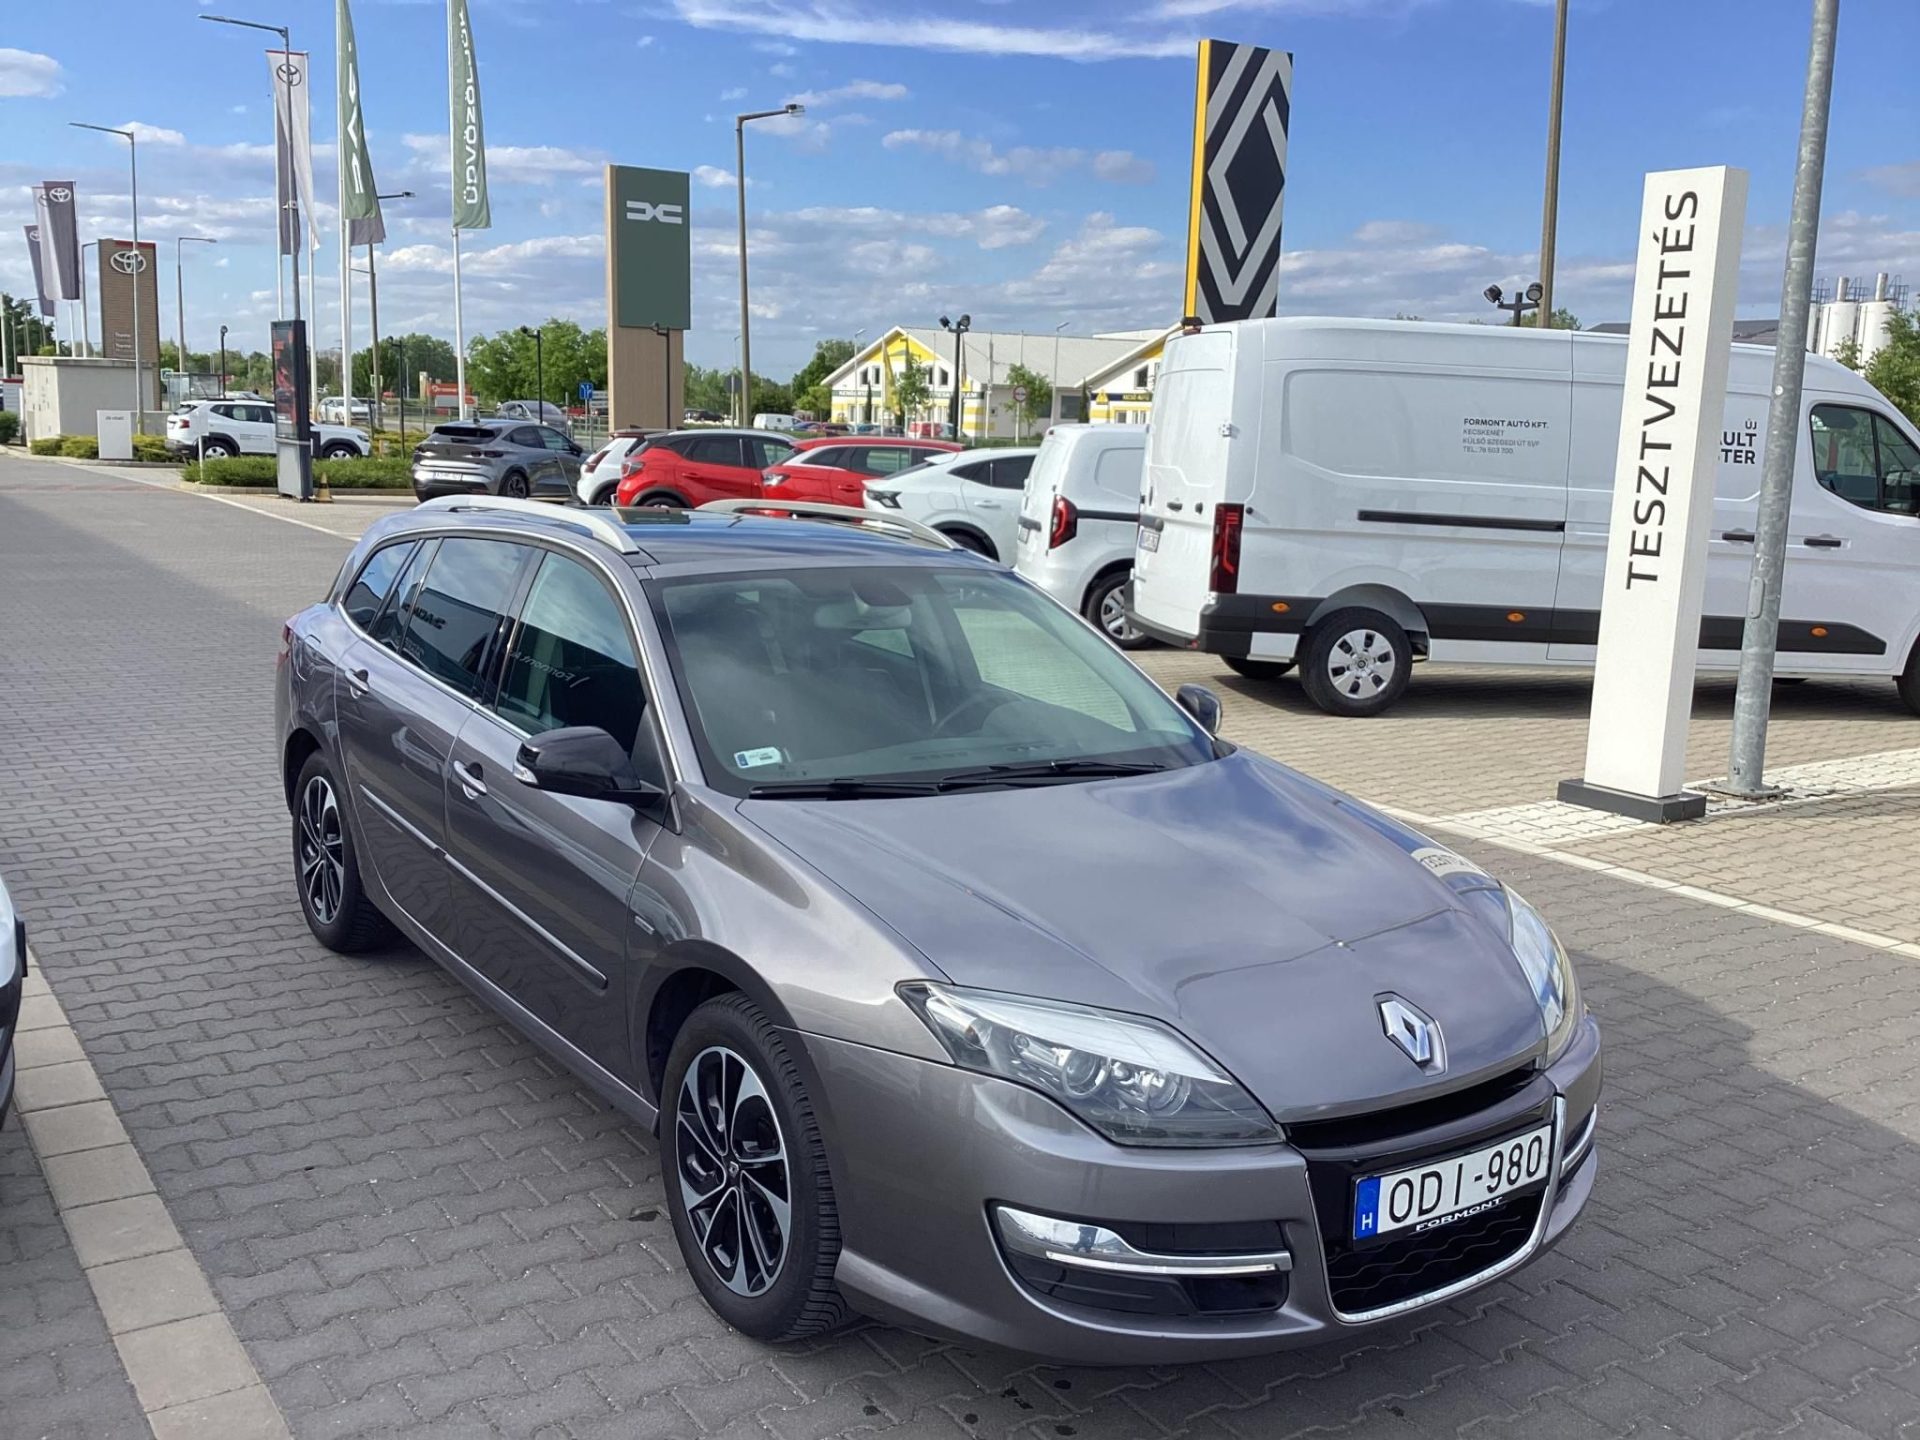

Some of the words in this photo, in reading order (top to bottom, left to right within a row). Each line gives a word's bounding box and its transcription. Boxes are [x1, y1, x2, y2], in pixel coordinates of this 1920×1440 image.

[1626, 190, 1699, 590] TESZTVEZETÉS
[1464, 418, 1506, 427] FORMONT
[1507, 419, 1530, 428] AUTÓ
[1745, 418, 1757, 430] ÚJ
[1720, 431, 1757, 447] ULT
[1718, 448, 1756, 465] TER
[1361, 1212, 1373, 1231] H
[1388, 1135, 1543, 1225] ODI-980
[1416, 1197, 1503, 1233] FORMONT
